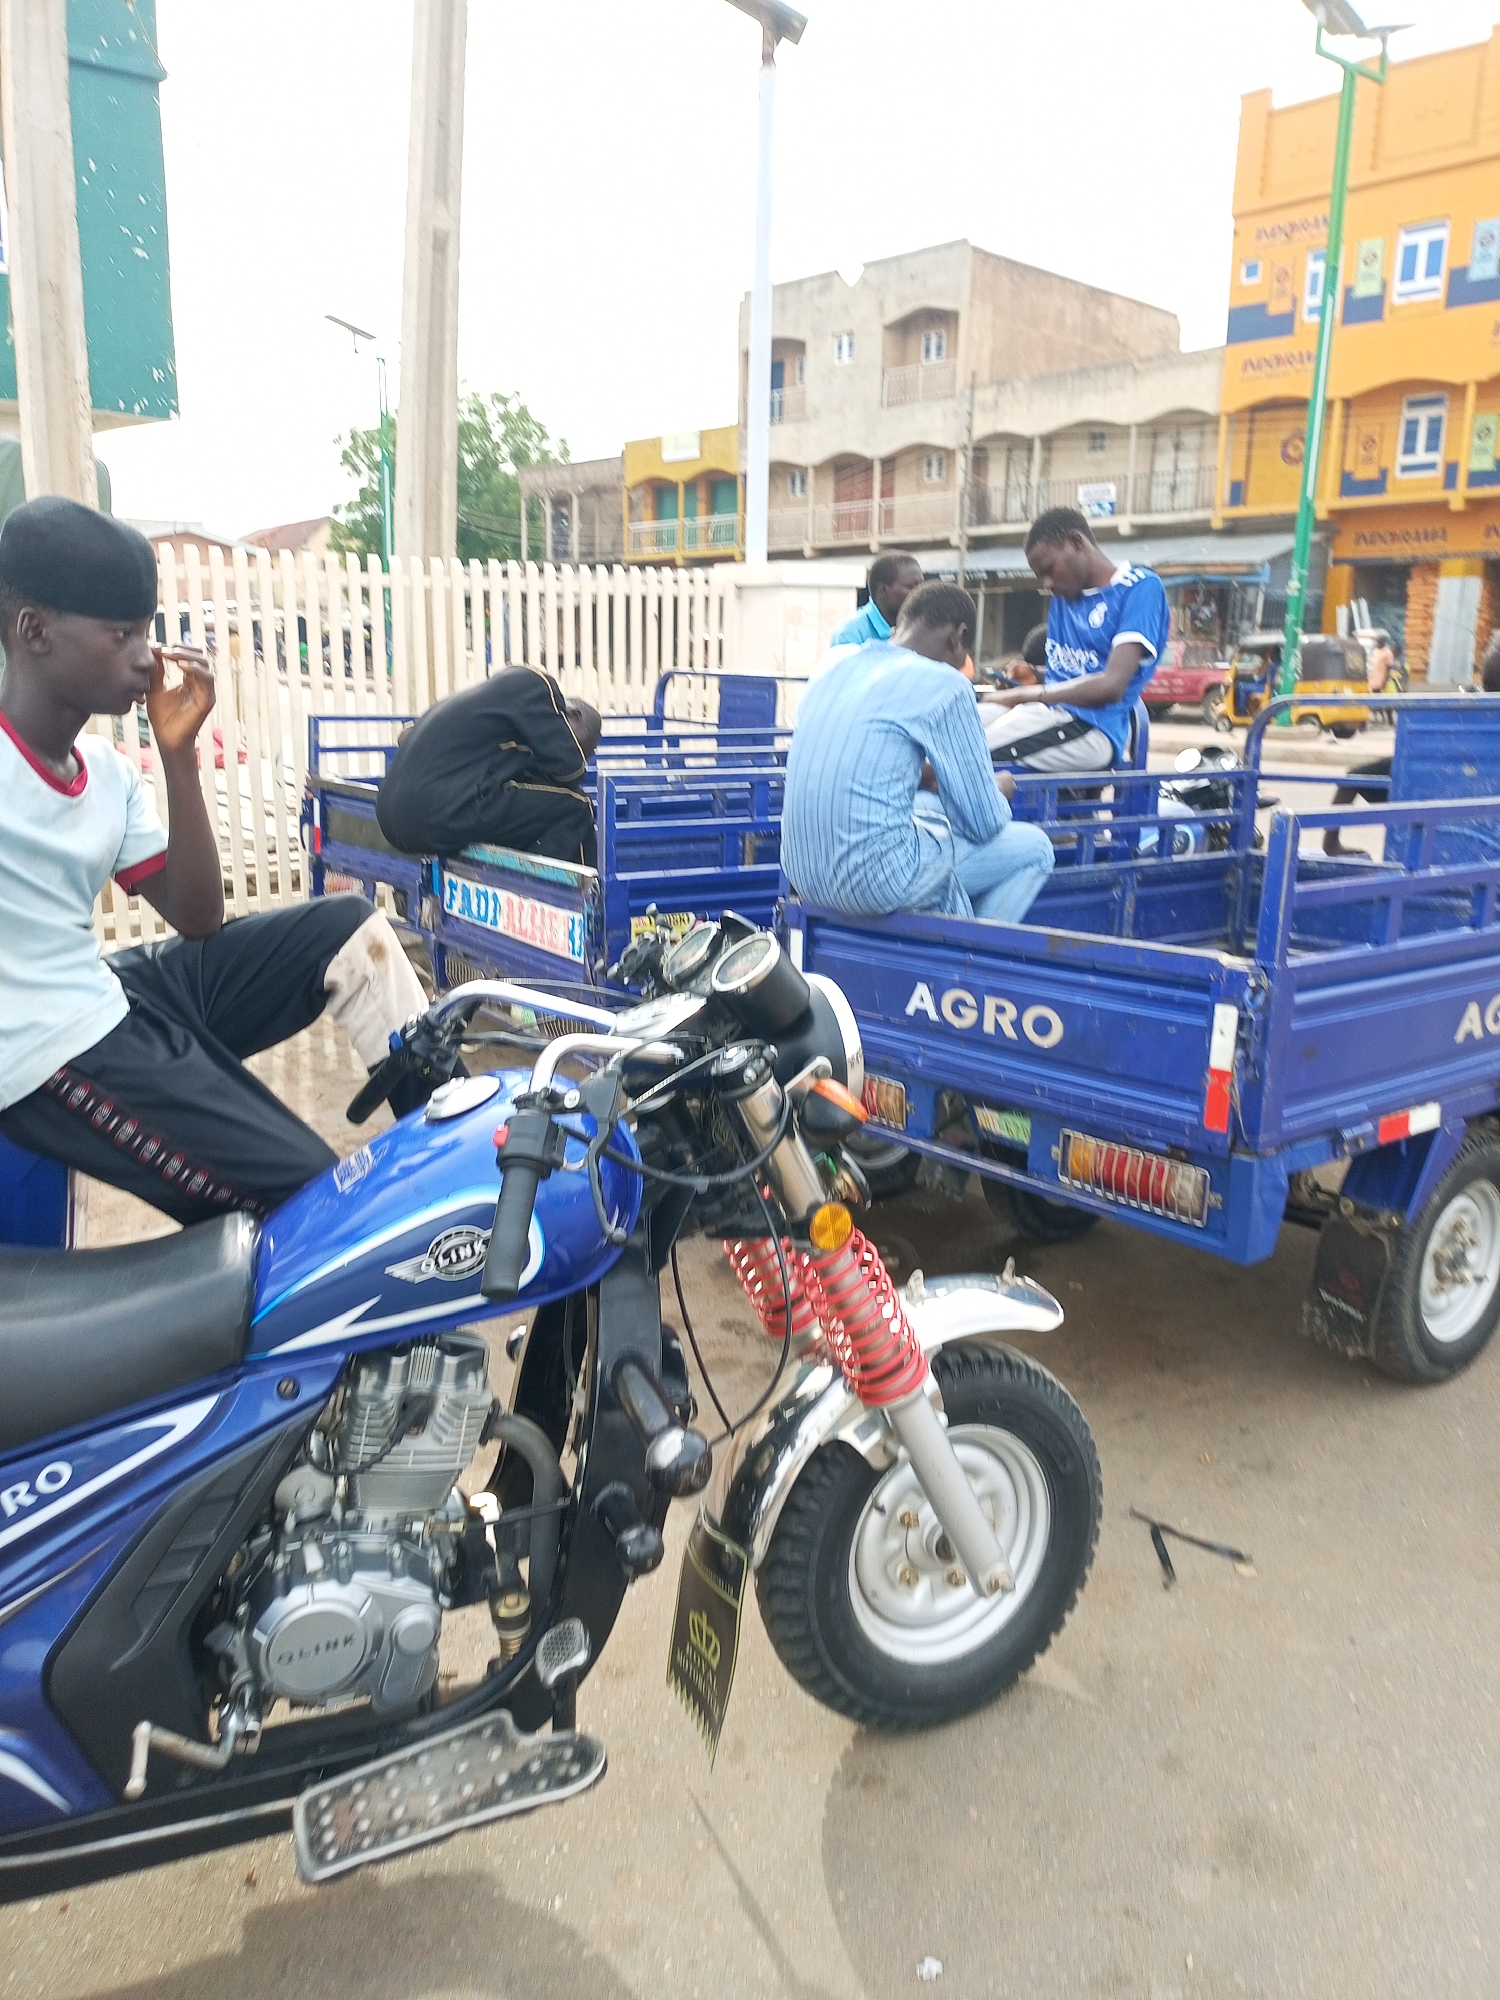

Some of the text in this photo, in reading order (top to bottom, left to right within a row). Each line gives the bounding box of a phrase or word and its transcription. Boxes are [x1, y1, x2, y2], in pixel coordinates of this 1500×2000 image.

[446, 877, 501, 927] FADI
[904, 981, 1065, 1049] AGRO
[0, 1460, 73, 1518] RO
[276, 1631, 355, 1667] OLINK
